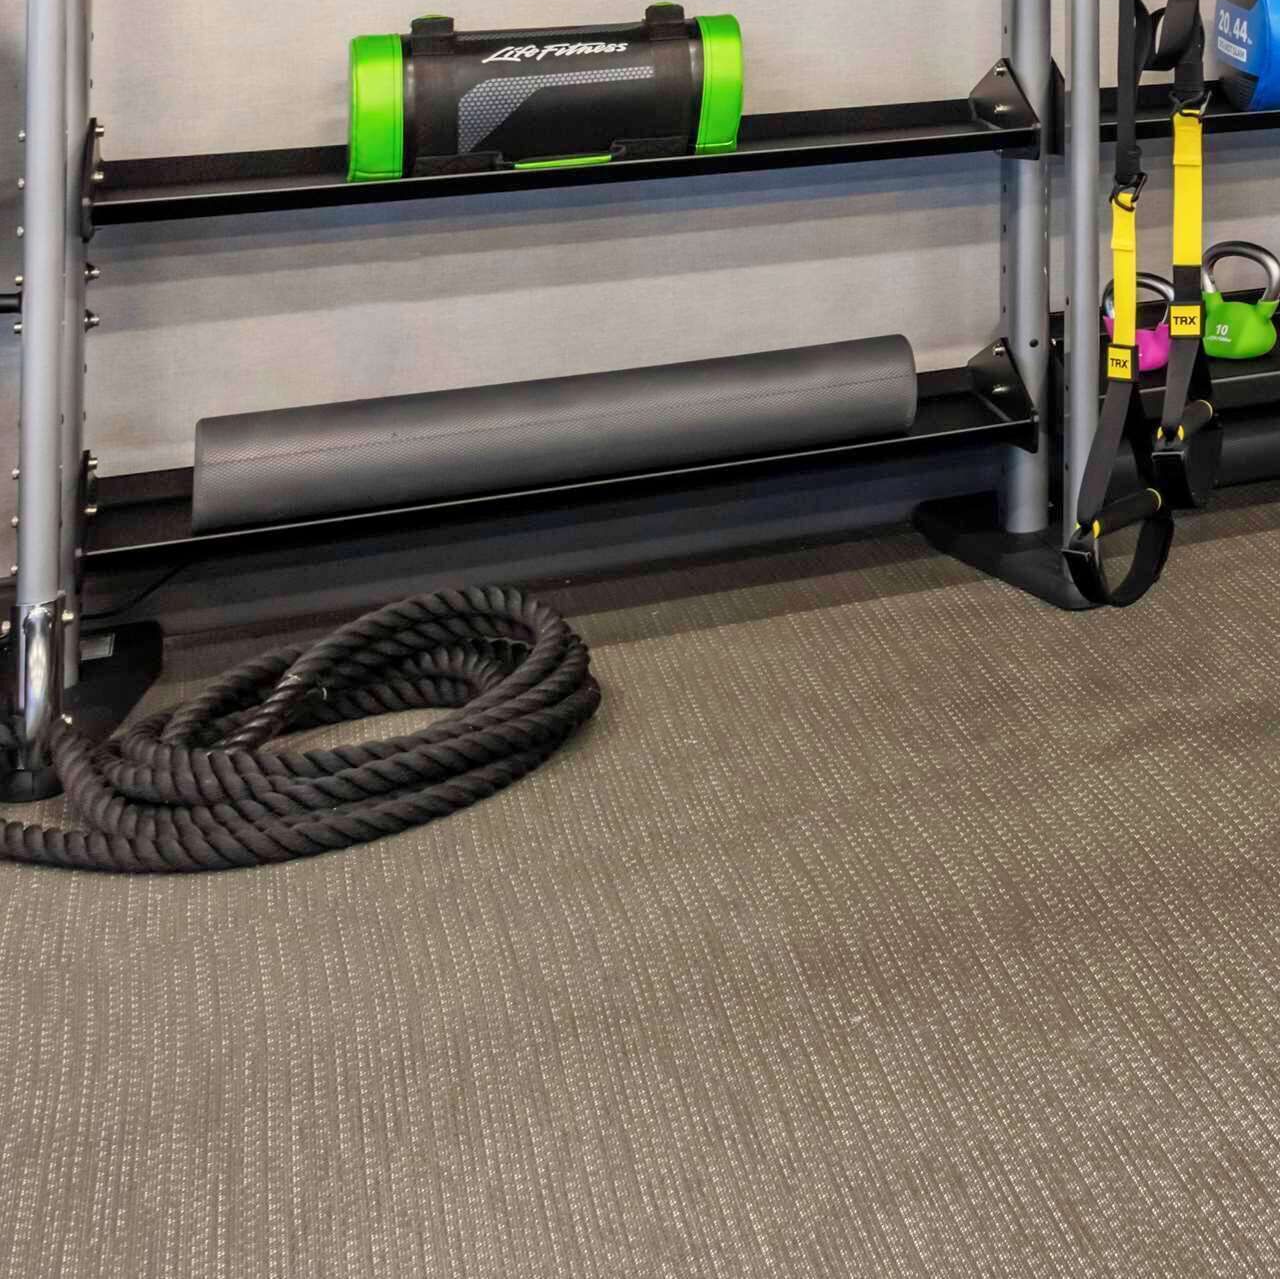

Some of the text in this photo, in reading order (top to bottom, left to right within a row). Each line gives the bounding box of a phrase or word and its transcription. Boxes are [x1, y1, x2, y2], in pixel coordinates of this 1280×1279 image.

[482, 41, 628, 63] Life Fitness
[1173, 316, 1197, 325] TRX
[1215, 324, 1229, 335] 10
[1110, 358, 1128, 368] TRX
